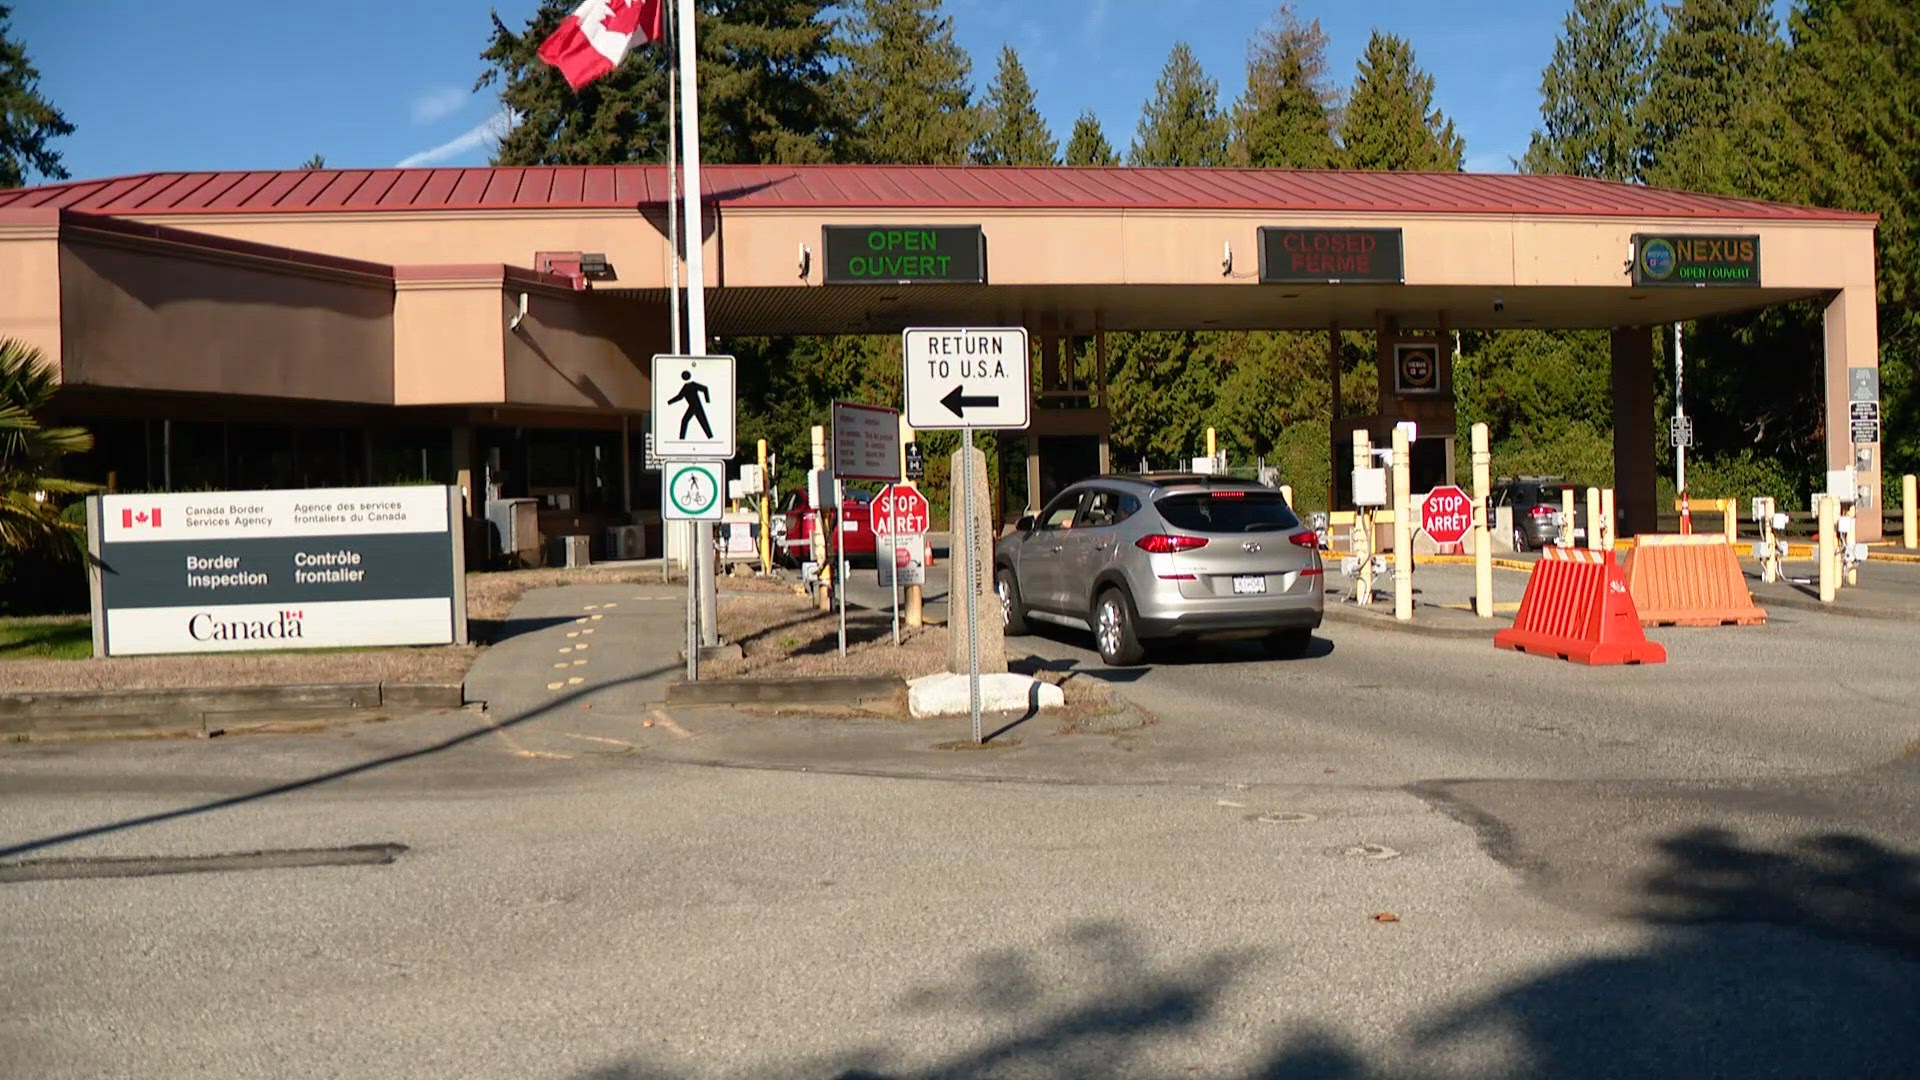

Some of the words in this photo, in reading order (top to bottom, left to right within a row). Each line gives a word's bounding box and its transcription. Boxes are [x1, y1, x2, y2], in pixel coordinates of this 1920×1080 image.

[867, 230, 937, 251] OPEN
[1283, 233, 1376, 253] CLOSED
[1677, 239, 1754, 261] NEXUS
[848, 255, 951, 276] OUVERT
[1291, 254, 1369, 273] FERME
[929, 337, 1003, 355] RETURN
[928, 360, 949, 378] TO
[960, 360, 1009, 378] U.S.A.
[185, 506, 225, 516] Canada
[229, 505, 264, 515] Border
[294, 503, 333, 514] Agence
[337, 502, 355, 512] des
[360, 501, 402, 511] services
[1429, 496, 1463, 513] STOP
[186, 516, 230, 527] Services
[234, 516, 272, 528] Agency
[294, 513, 346, 524] frontaliers
[350, 512, 364, 522] du
[368, 511, 407, 522] Canada
[1426, 511, 1468, 532] ARRÊT
[187, 555, 240, 570] Border
[294, 550, 361, 567] Contrôle
[187, 571, 268, 588] Inspection
[295, 568, 365, 584] frontalier
[975, 559, 983, 596] UNITED
[188, 610, 304, 641] Canada
